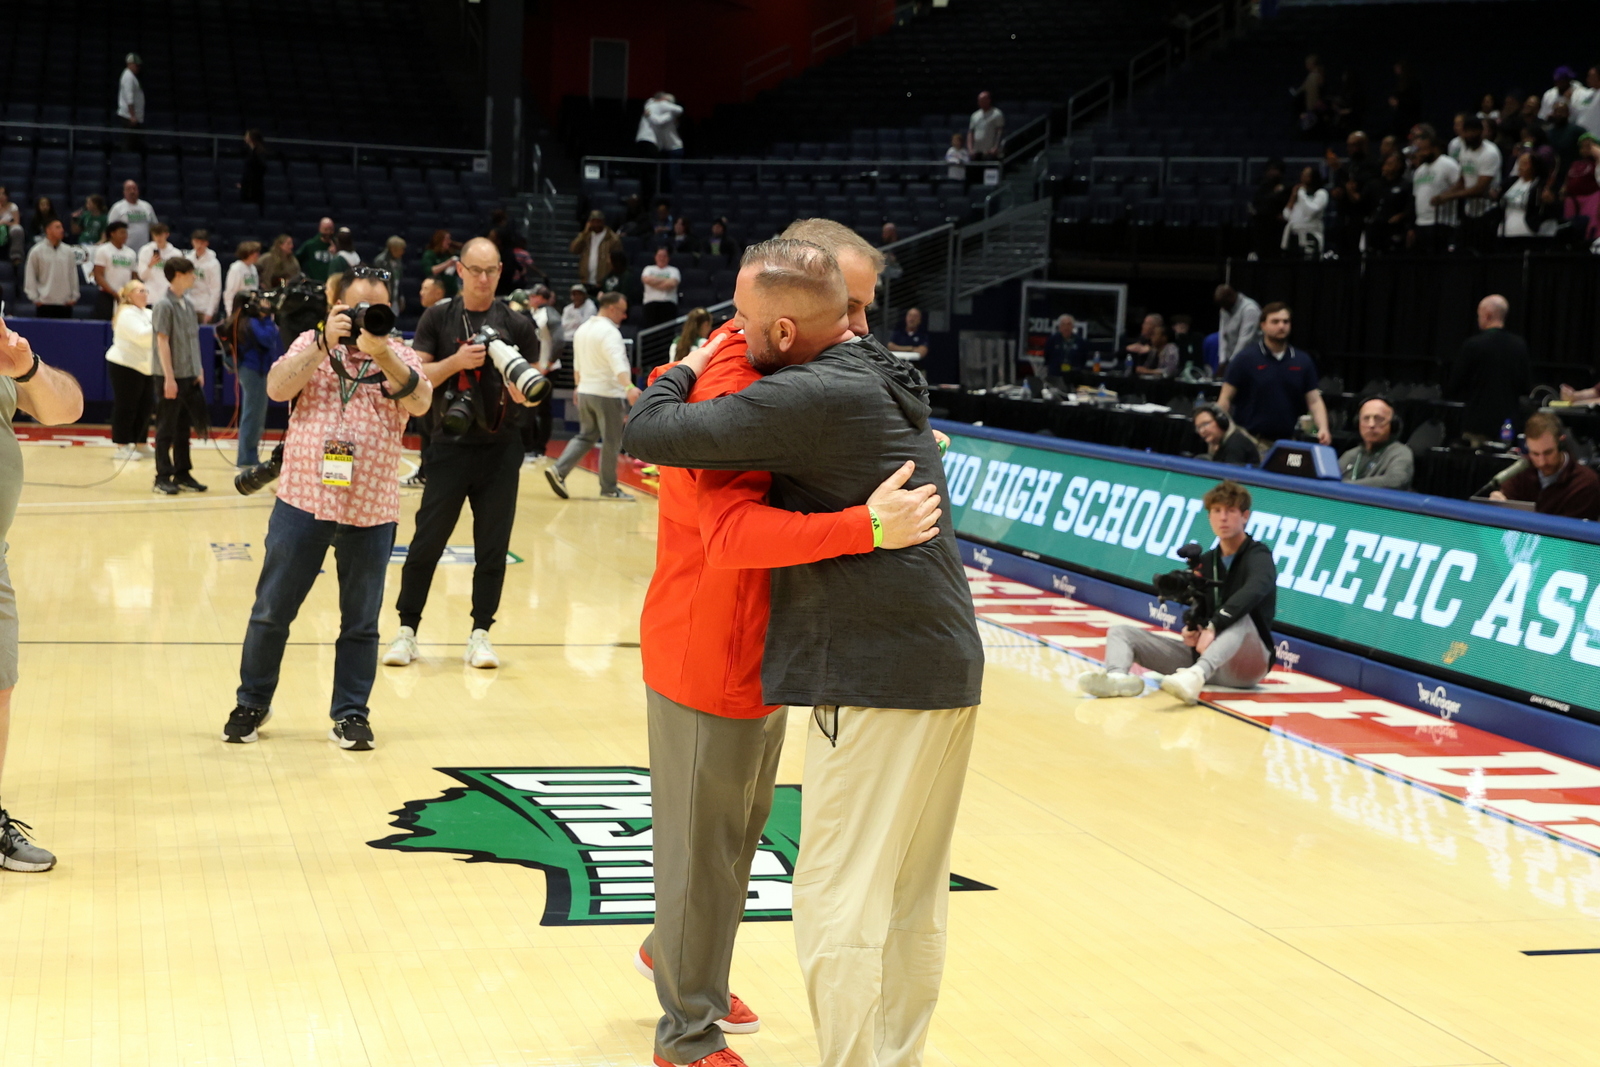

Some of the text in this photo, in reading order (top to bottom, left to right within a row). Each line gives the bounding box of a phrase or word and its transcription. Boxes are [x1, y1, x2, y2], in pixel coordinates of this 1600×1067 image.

[972, 460, 1063, 527] HIGH
[1053, 476, 1204, 563] SCHOOL
[1210, 511, 1477, 628] THLETIC
[1430, 686, 1462, 719] Kroger
